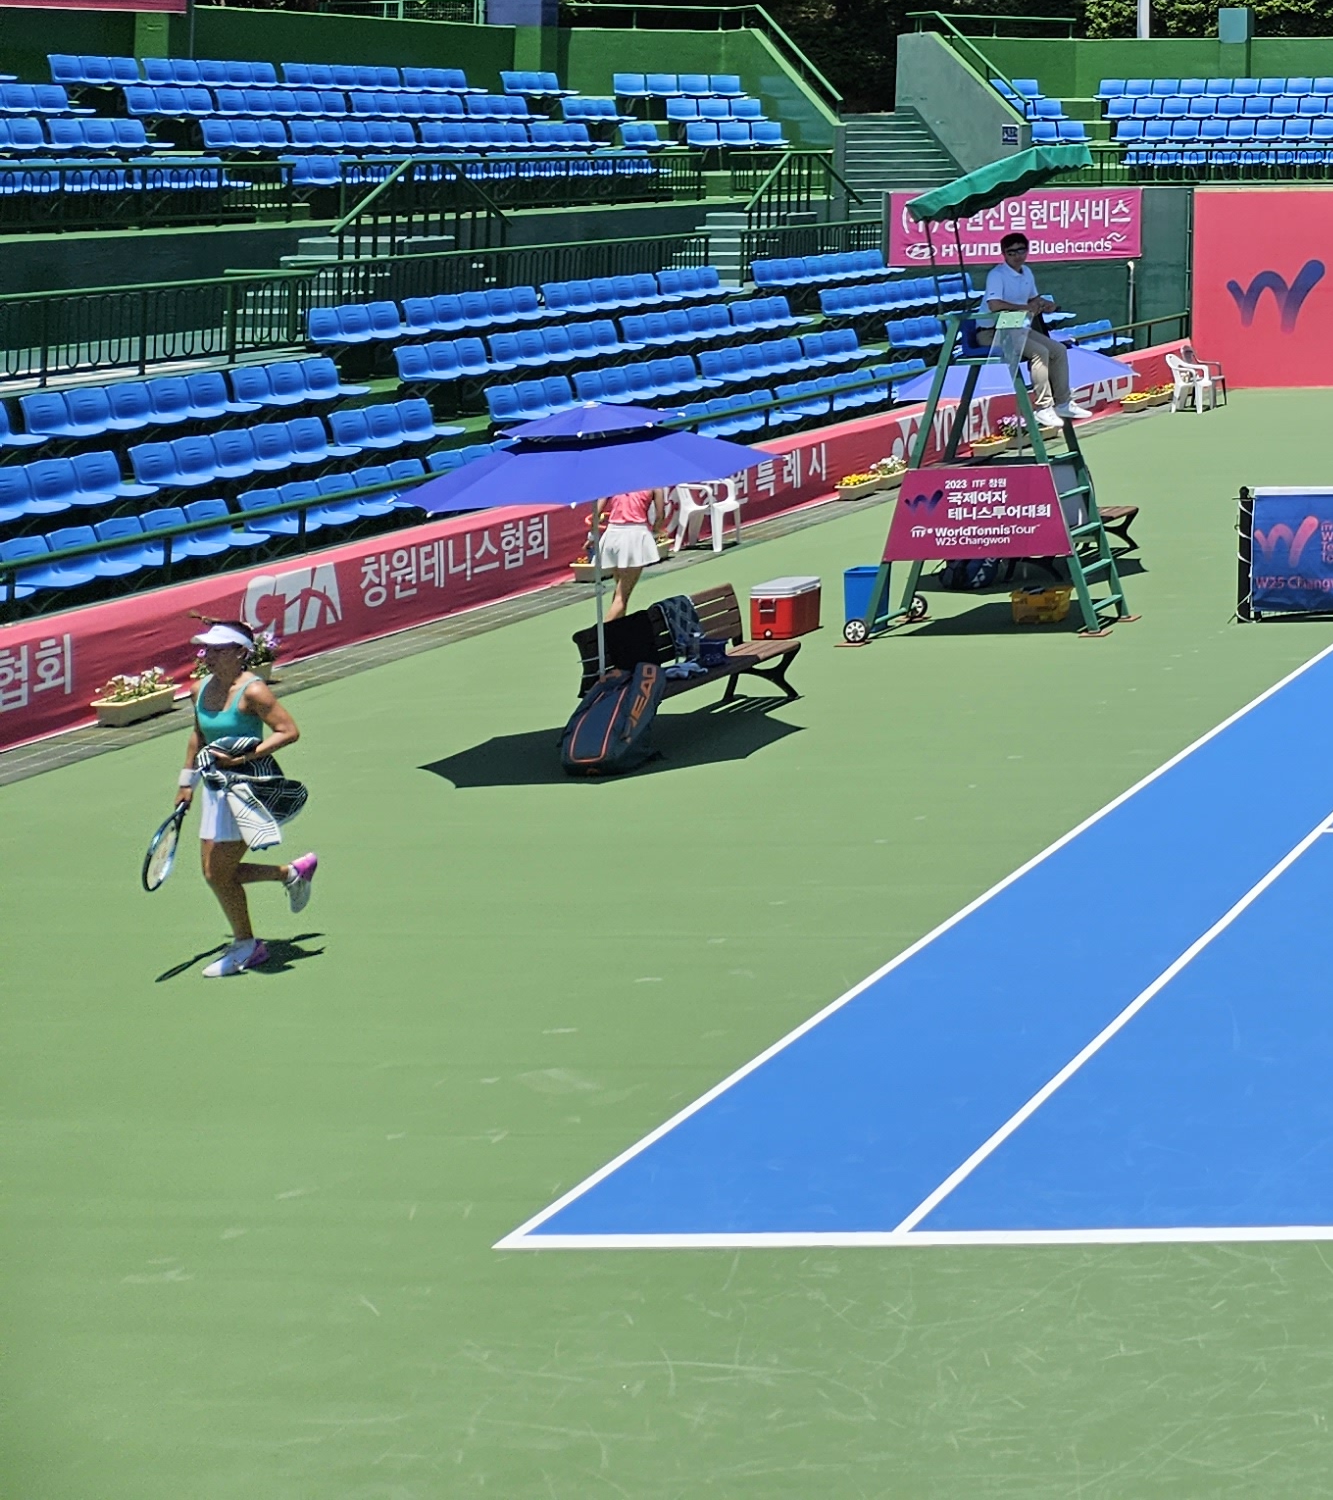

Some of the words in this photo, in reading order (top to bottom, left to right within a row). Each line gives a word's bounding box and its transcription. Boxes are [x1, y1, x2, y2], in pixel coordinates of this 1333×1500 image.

[941, 243, 1001, 257] HYUND
[1029, 237, 1112, 255] Bluehands
[944, 480, 967, 490] 2023
[972, 479, 985, 488] ITF
[988, 477, 1007, 488] 창원
[947, 490, 1008, 504] 국제여자
[948, 504, 1051, 520] 테니스투어대회
[935, 536, 957, 546] W25
[959, 535, 1010, 547] Changwon
[359, 514, 549, 608] 창원테니스협회
[1255, 575, 1285, 589] W25
